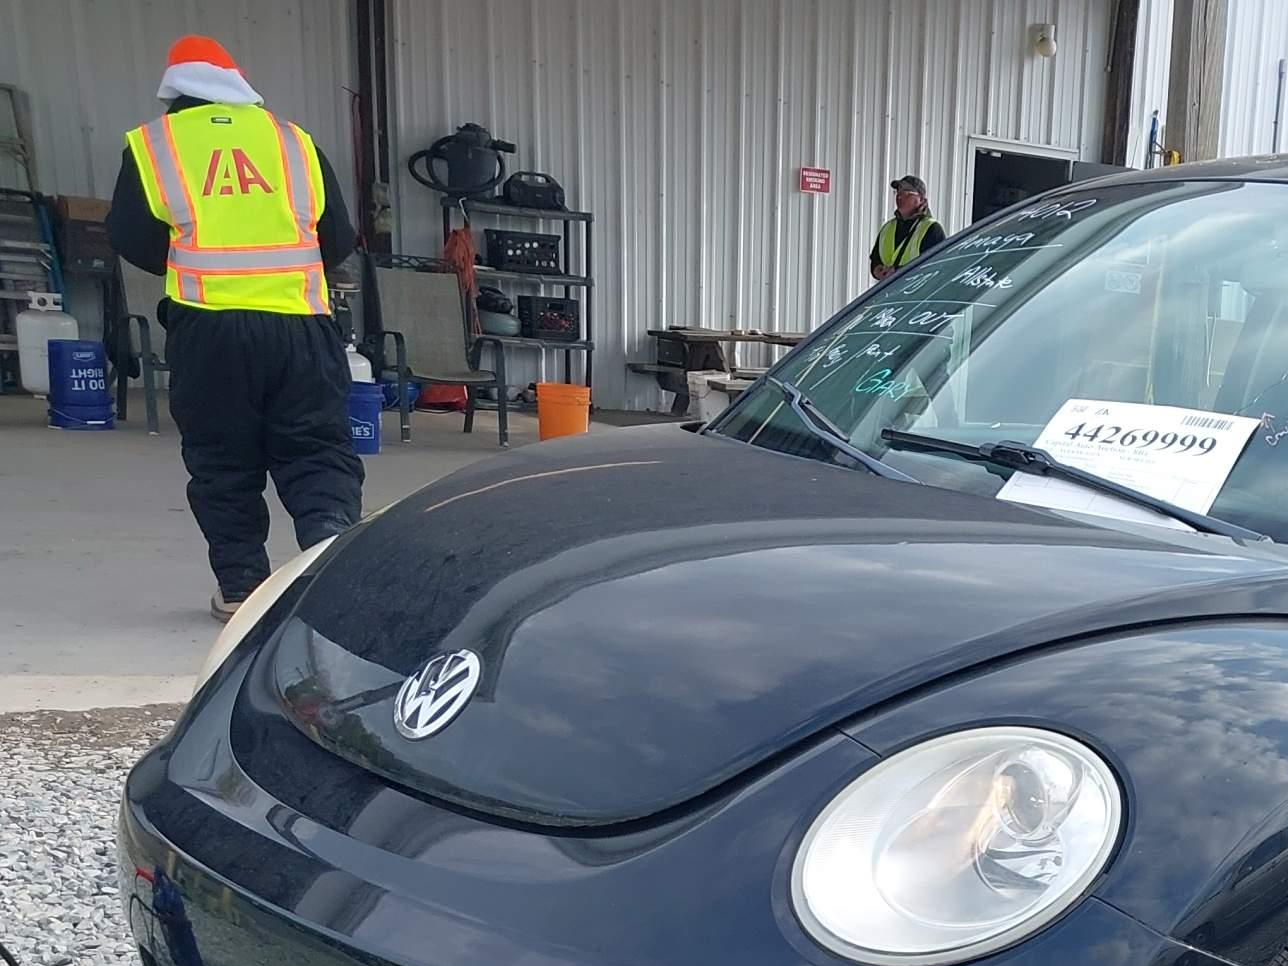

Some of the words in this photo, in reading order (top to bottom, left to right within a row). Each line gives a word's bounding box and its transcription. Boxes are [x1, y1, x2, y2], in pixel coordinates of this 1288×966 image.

[69, 367, 105, 379] RIGHT
[71, 379, 86, 391] IT
[89, 378, 106, 391] DO
[1063, 421, 1219, 457] 44269999
